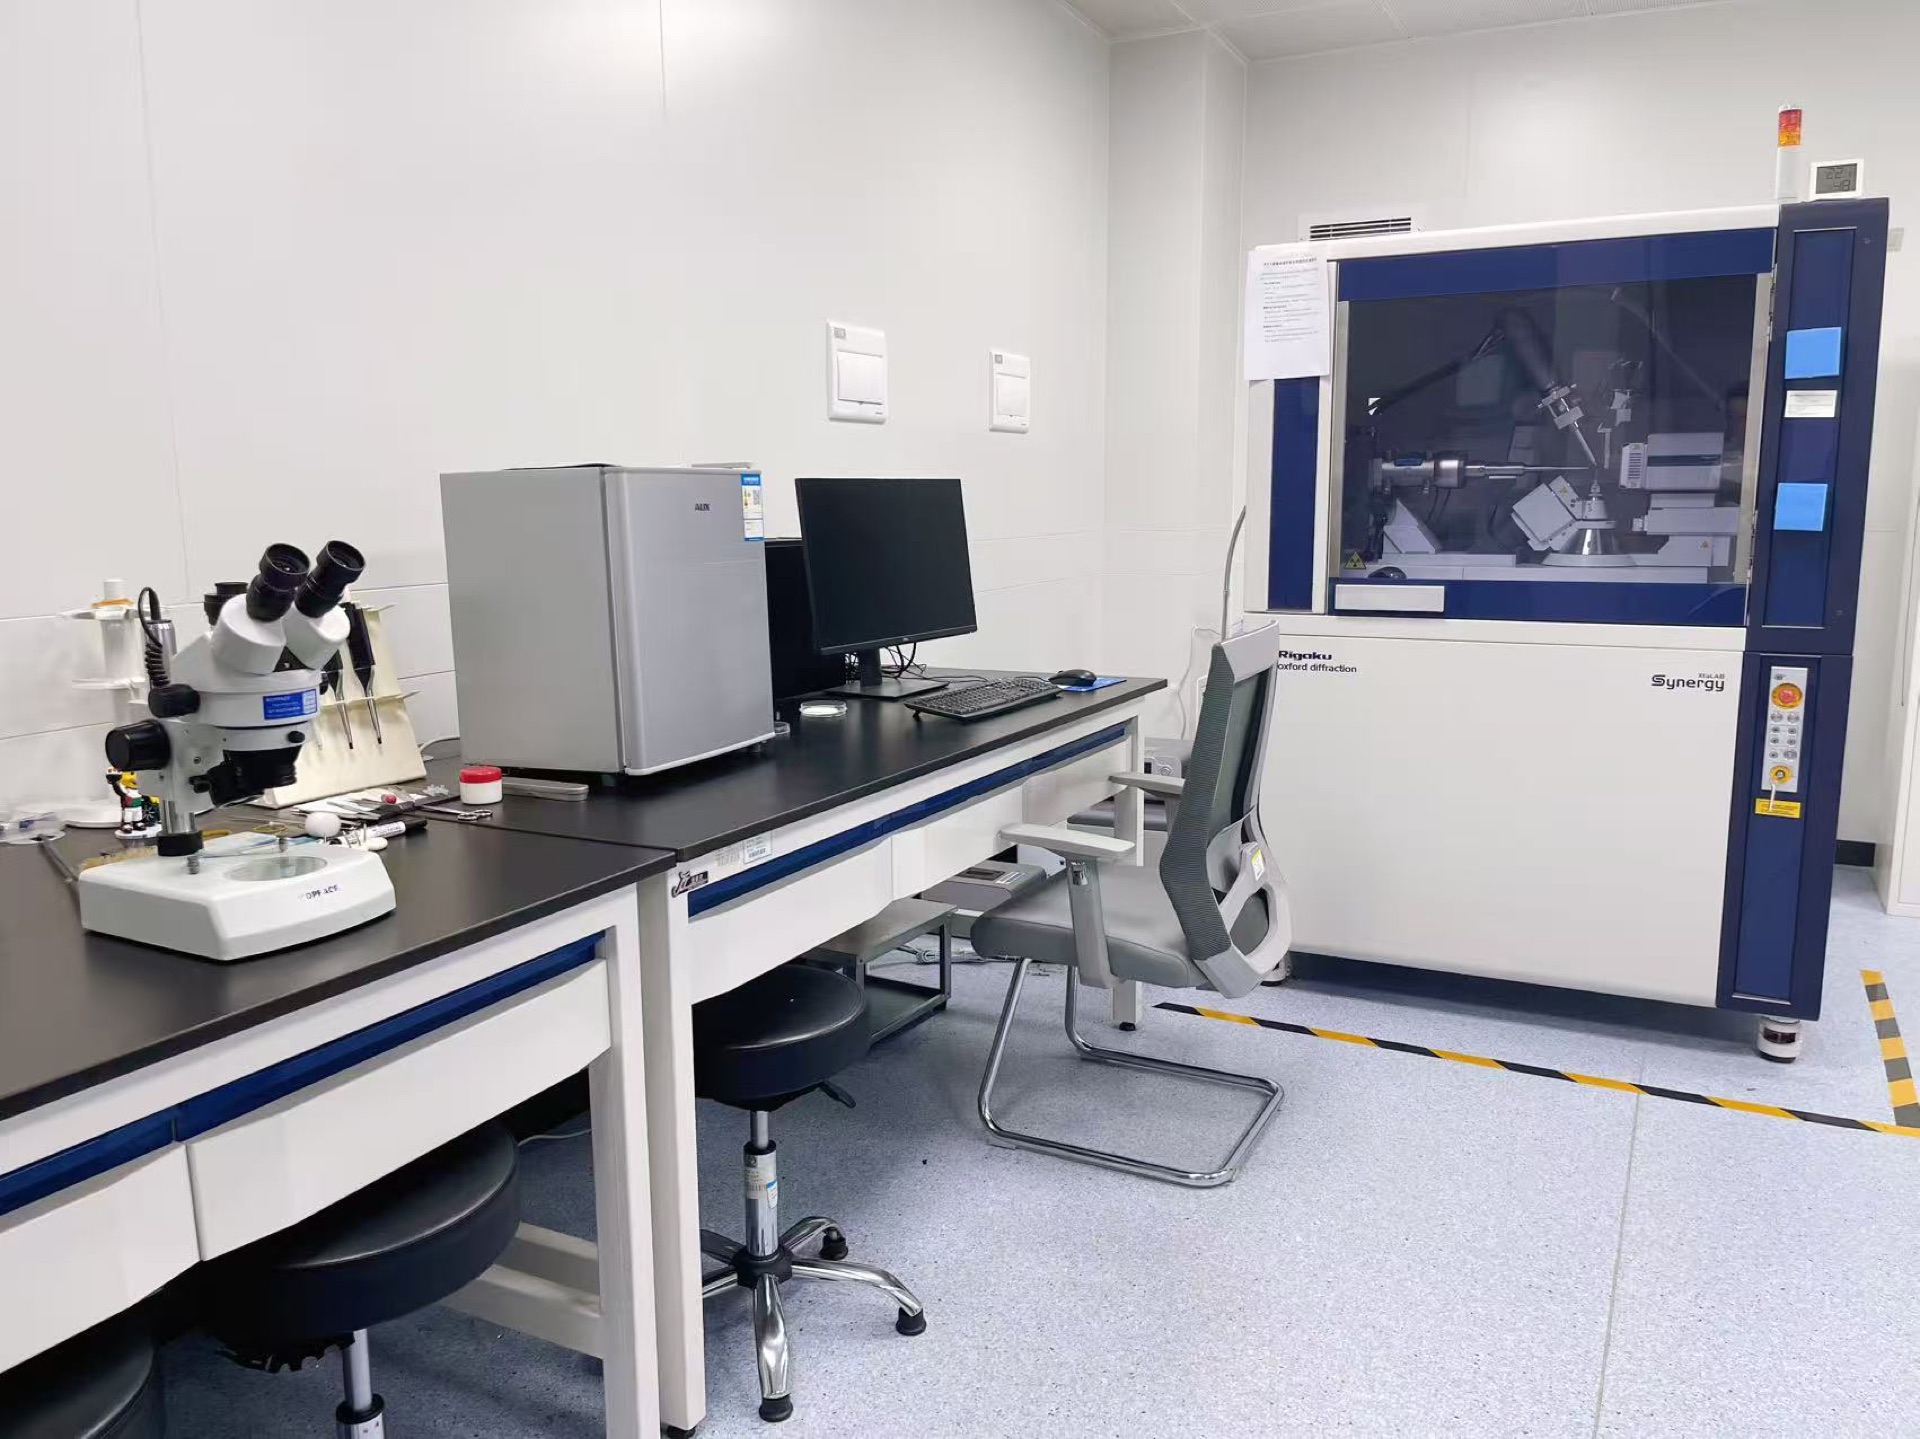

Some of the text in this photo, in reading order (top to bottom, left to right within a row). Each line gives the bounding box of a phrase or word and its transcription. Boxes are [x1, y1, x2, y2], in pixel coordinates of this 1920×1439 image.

[1278, 650, 1332, 660] Rigaku
[1277, 663, 1357, 672] oxford diffraction
[1651, 674, 1724, 692] Synergy
